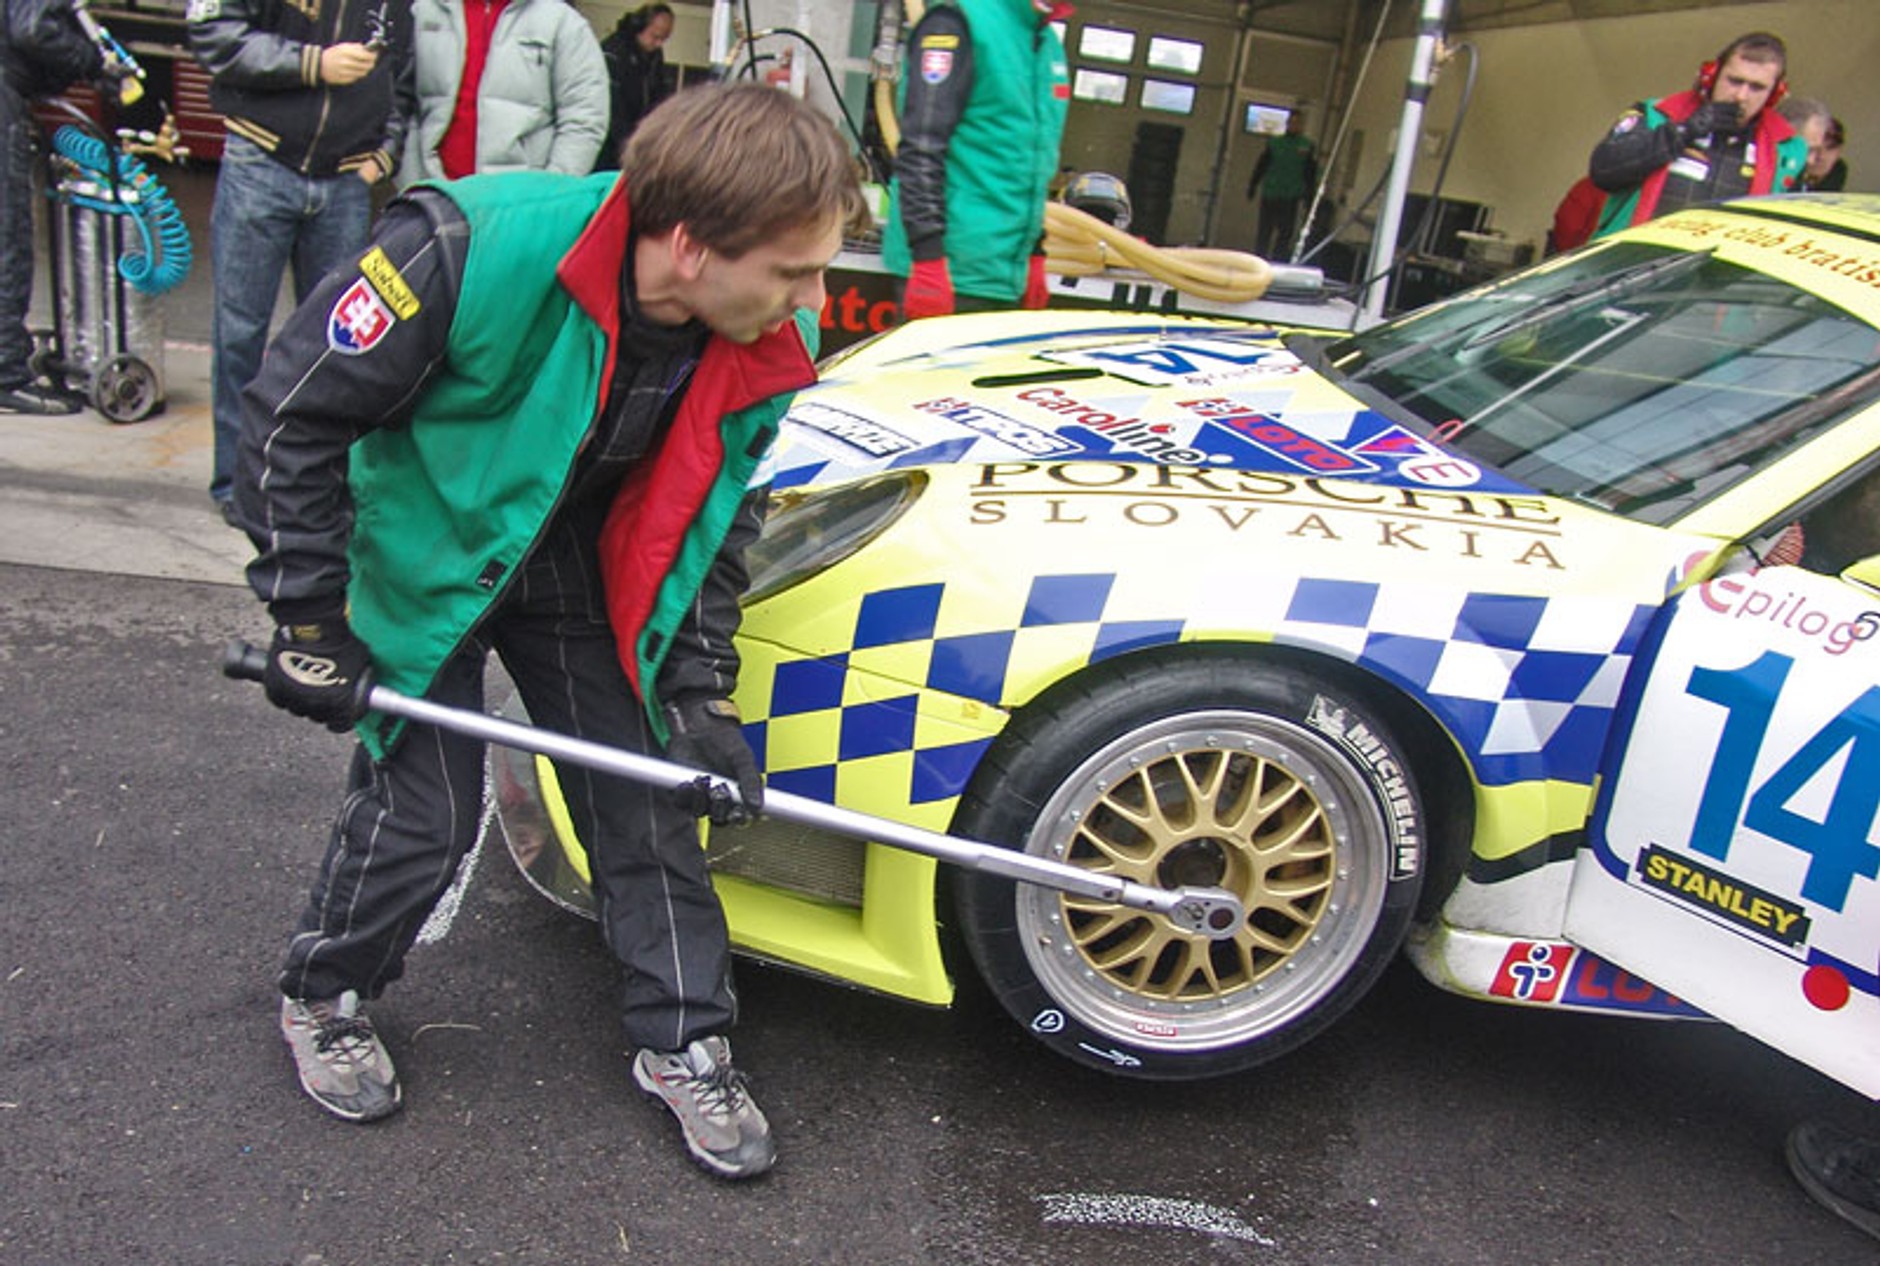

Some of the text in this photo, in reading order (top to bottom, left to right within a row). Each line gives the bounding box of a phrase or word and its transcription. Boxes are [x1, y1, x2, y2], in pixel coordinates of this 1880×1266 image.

[1723, 227, 1789, 249] club
[1016, 386, 1202, 465] Carolline
[1227, 415, 1355, 470] LOTO
[969, 499, 1567, 570] SLOVAKIA
[1692, 566, 1864, 655] Epilog
[1346, 722, 1420, 873] MICHELIN
[1684, 649, 1880, 915] 14
[1646, 854, 1799, 935] STANLEY
